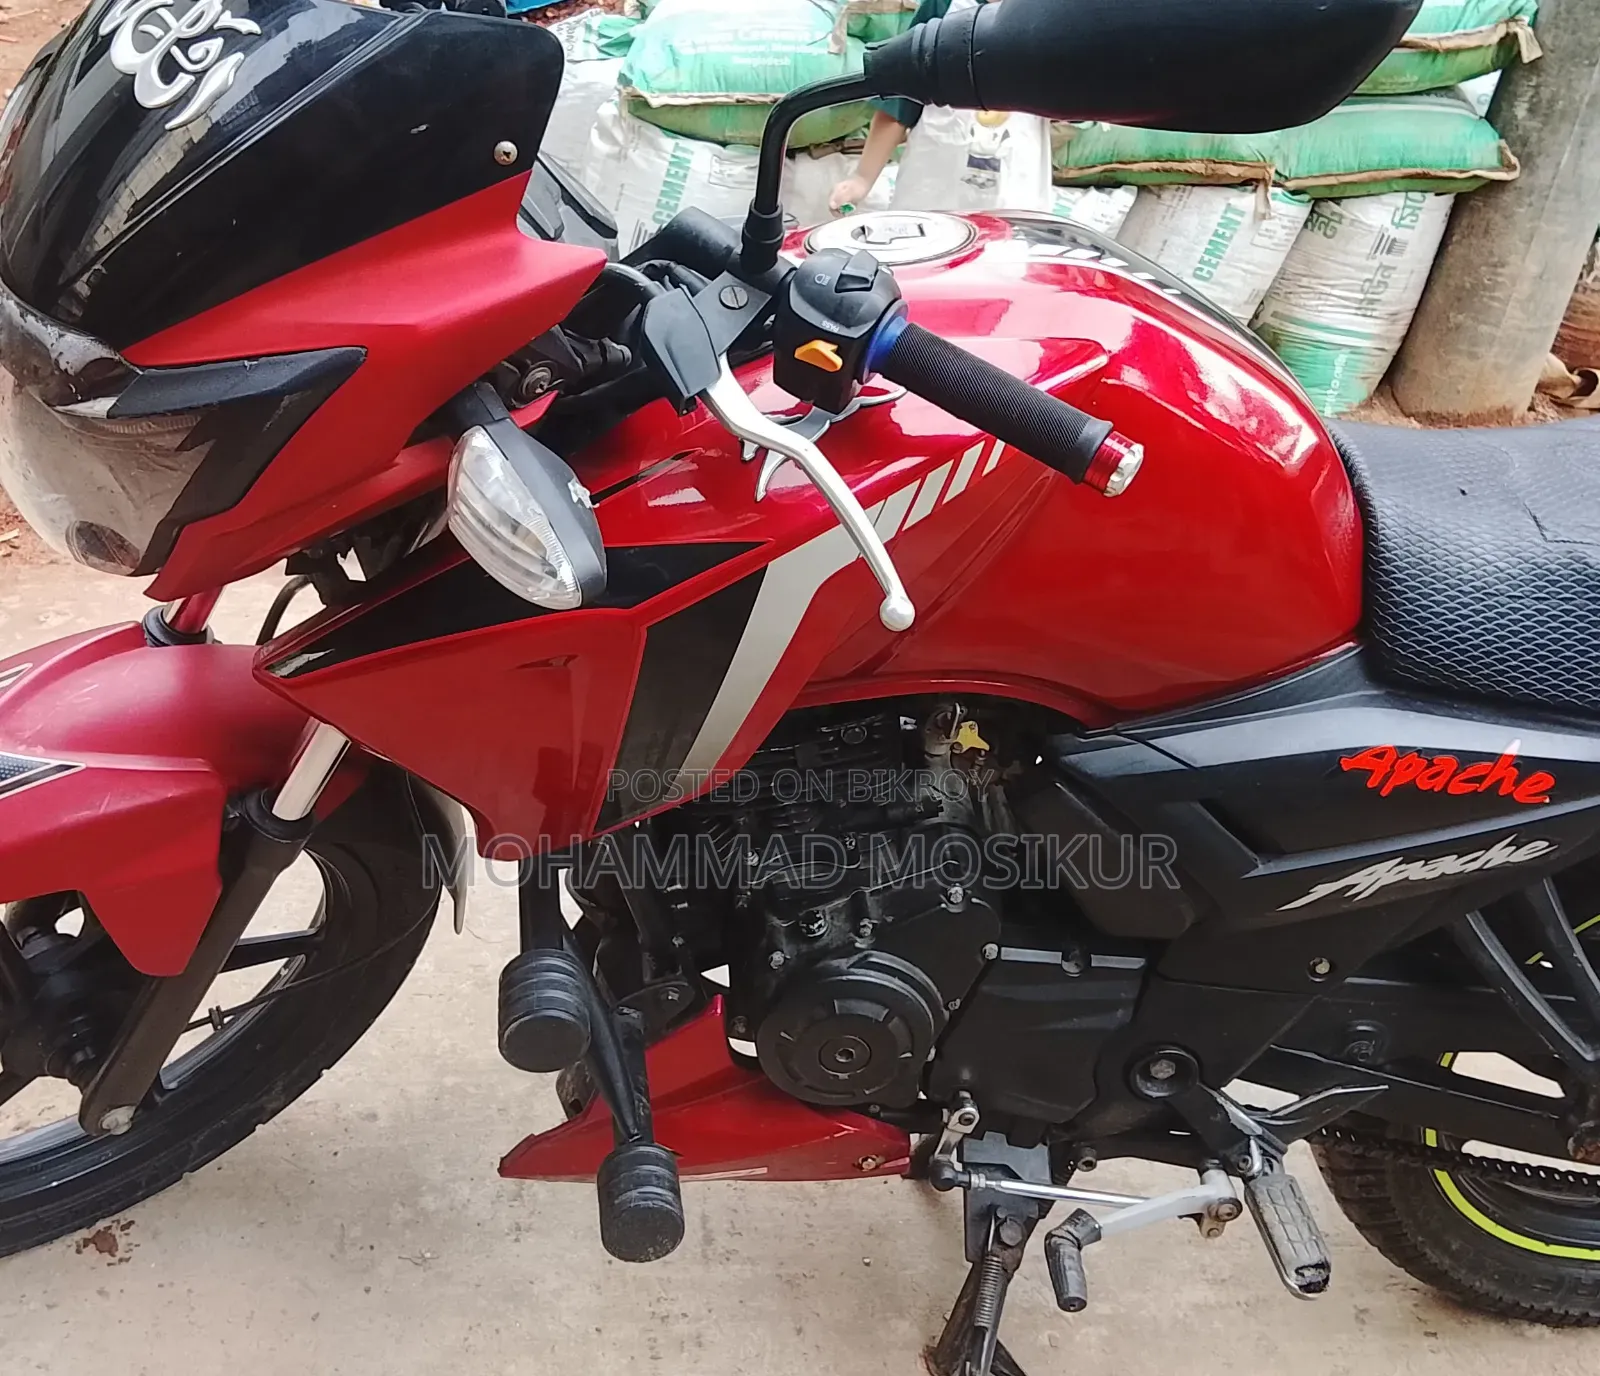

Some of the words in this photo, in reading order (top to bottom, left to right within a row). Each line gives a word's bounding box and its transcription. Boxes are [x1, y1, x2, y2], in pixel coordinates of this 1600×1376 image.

[651, 141, 695, 224] CEMENT
[1192, 202, 1247, 283] CEMENT
[821, 320, 840, 333] PASS
[1339, 738, 1556, 804] Apache
[1275, 833, 1559, 911] Apache
